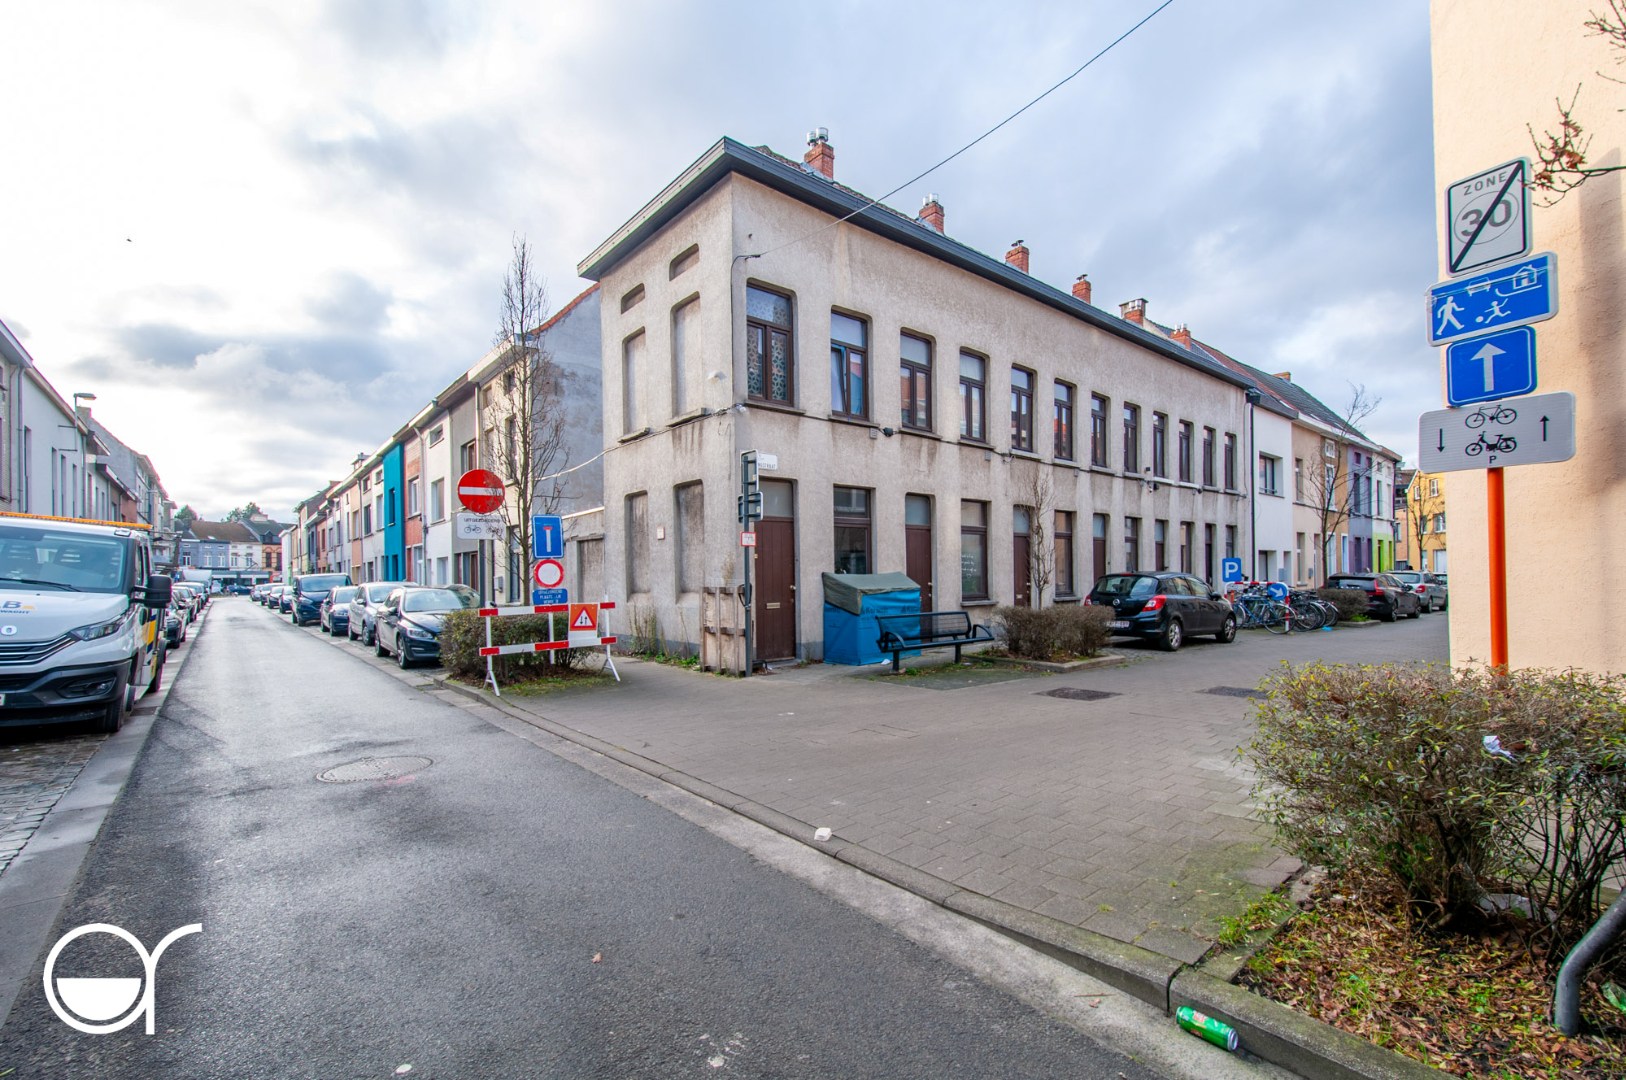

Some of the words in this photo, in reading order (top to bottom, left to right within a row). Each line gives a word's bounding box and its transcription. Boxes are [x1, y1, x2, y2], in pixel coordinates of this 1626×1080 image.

[1464, 172, 1507, 195] ZONE
[1461, 200, 1511, 236] 30
[1489, 455, 1497, 464] P
[1225, 562, 1239, 579] P
